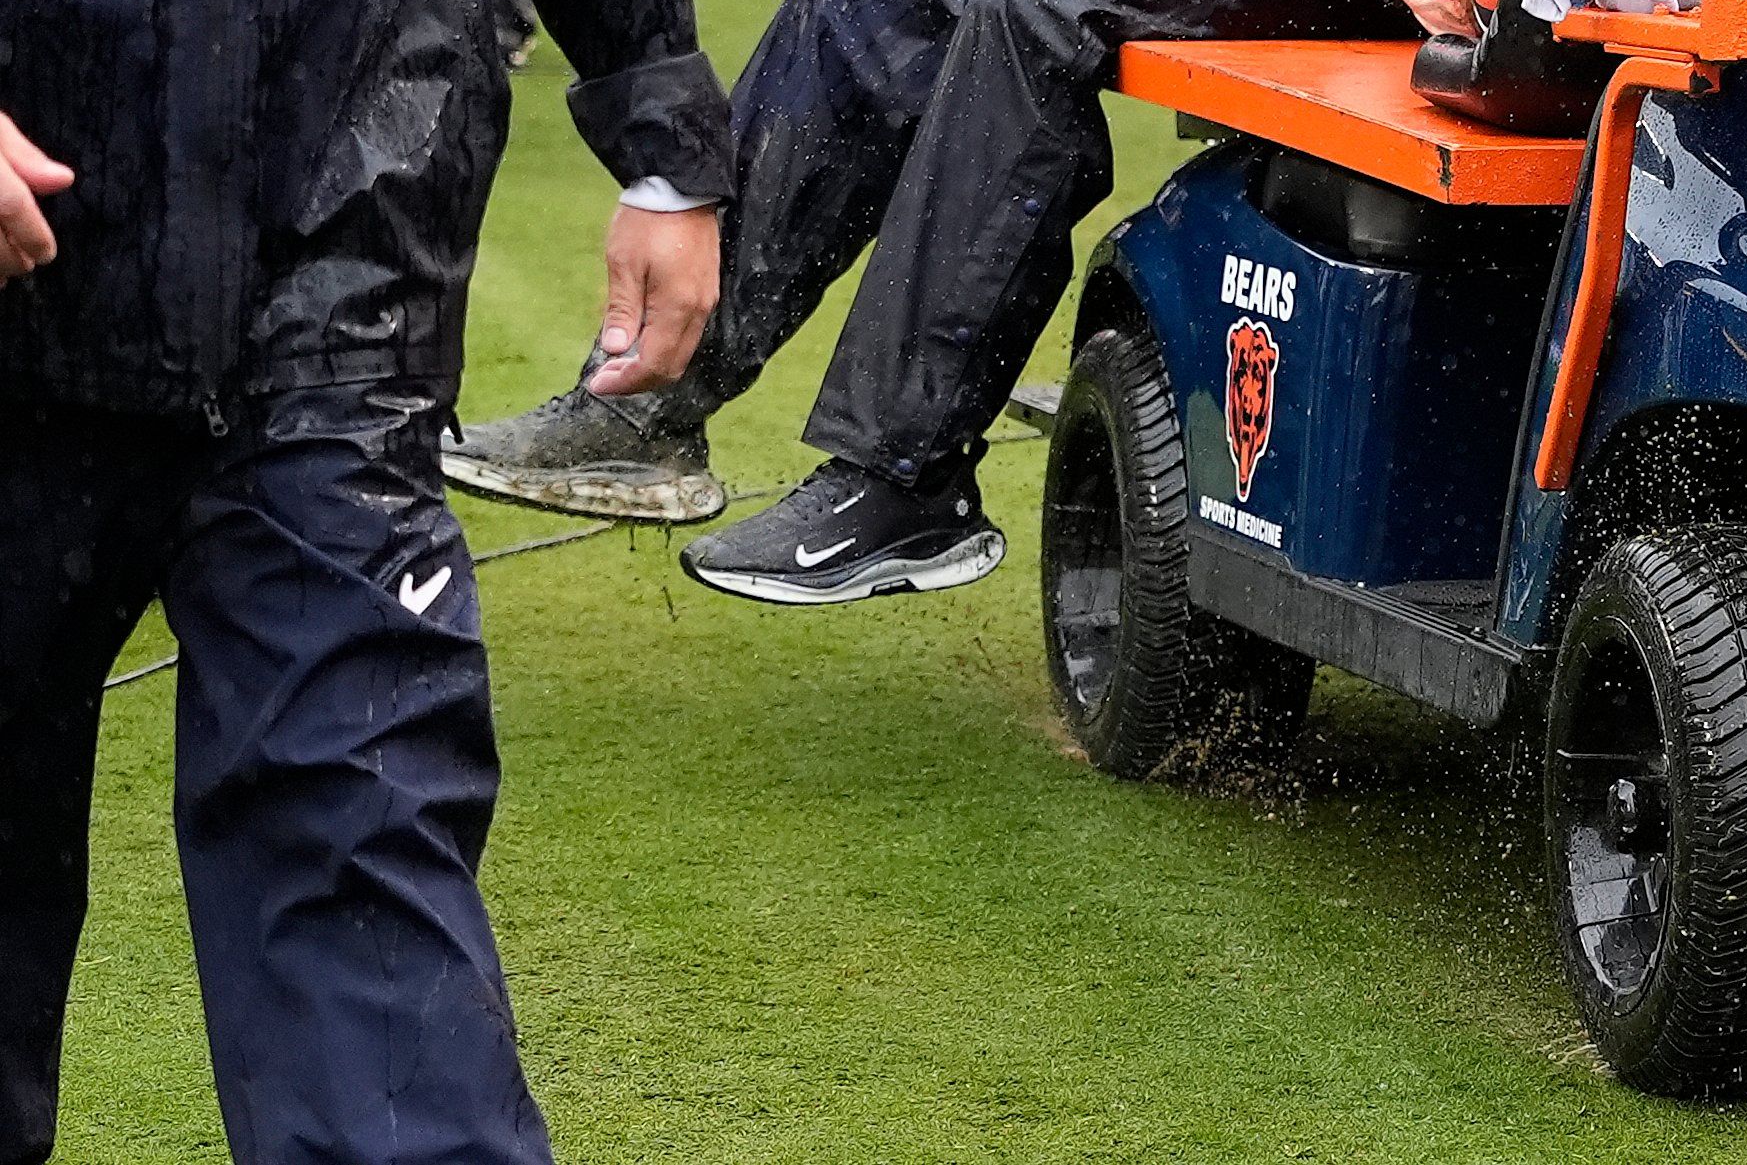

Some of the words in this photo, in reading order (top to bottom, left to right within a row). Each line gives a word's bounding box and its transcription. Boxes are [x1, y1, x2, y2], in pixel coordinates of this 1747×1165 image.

[1221, 254, 1297, 322] BEARS
[1200, 495, 1236, 529] SPORTS
[1236, 509, 1283, 549] MEDICINE
